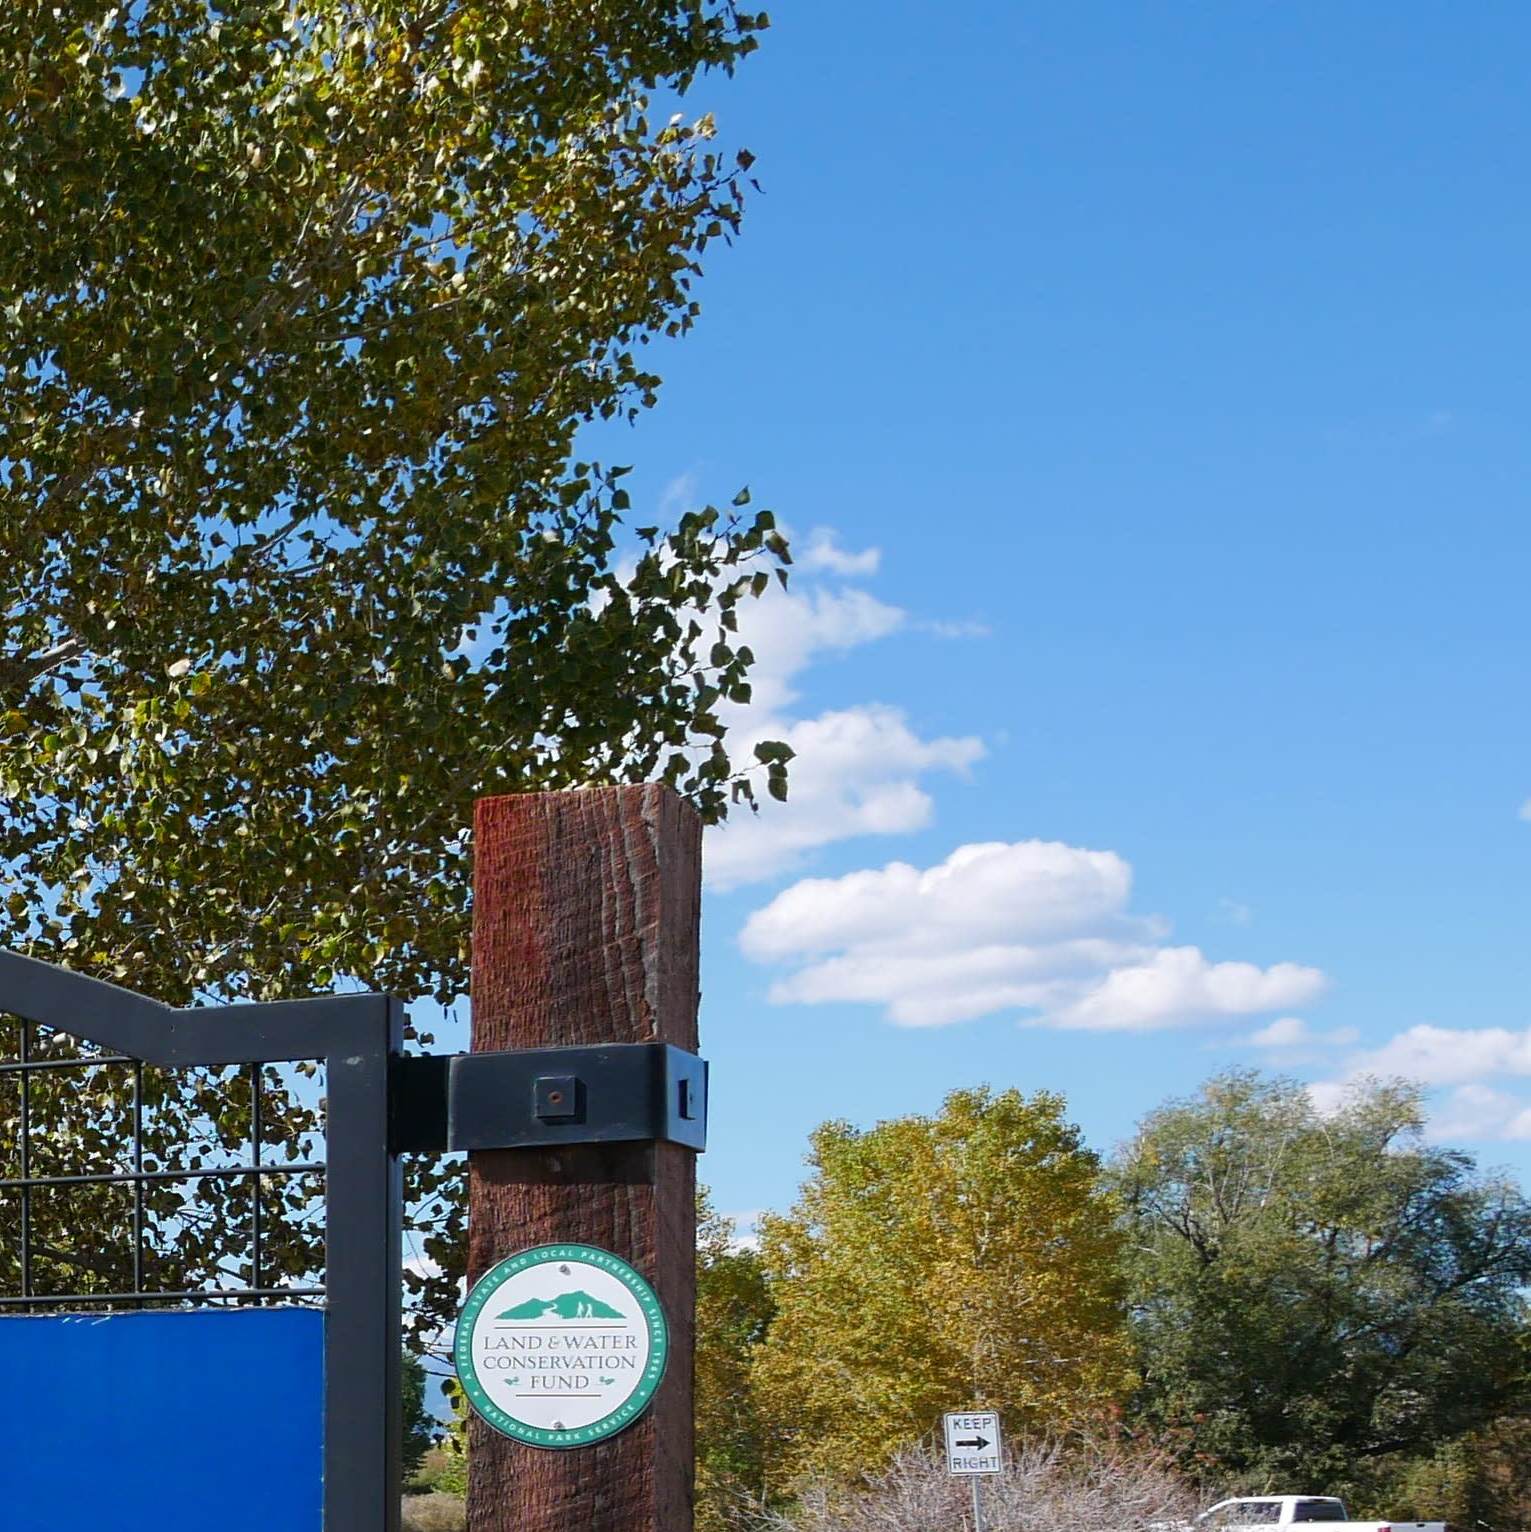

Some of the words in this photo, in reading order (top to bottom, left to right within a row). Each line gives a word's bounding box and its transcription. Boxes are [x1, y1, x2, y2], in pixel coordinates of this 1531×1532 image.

[534, 1249, 573, 1260] LOCAL
[504, 1257, 527, 1274] AND
[581, 1251, 651, 1303] PARTNERSHIP
[471, 1275, 499, 1307] STATE
[648, 1308, 662, 1343] SINCE
[459, 1315, 473, 1367] FEDERAL
[484, 1336, 542, 1350] LAND
[548, 1336, 559, 1349] &
[563, 1335, 637, 1349] WATER
[483, 1355, 636, 1370] CONSERVATION
[464, 1372, 473, 1381] A
[531, 1376, 589, 1389] FUND
[485, 1405, 539, 1440] NATIONAL
[548, 1433, 580, 1441] PARK
[588, 1404, 635, 1436] SERVICE
[953, 1418, 991, 1430] KEEP
[953, 1457, 997, 1469] RIGHT
